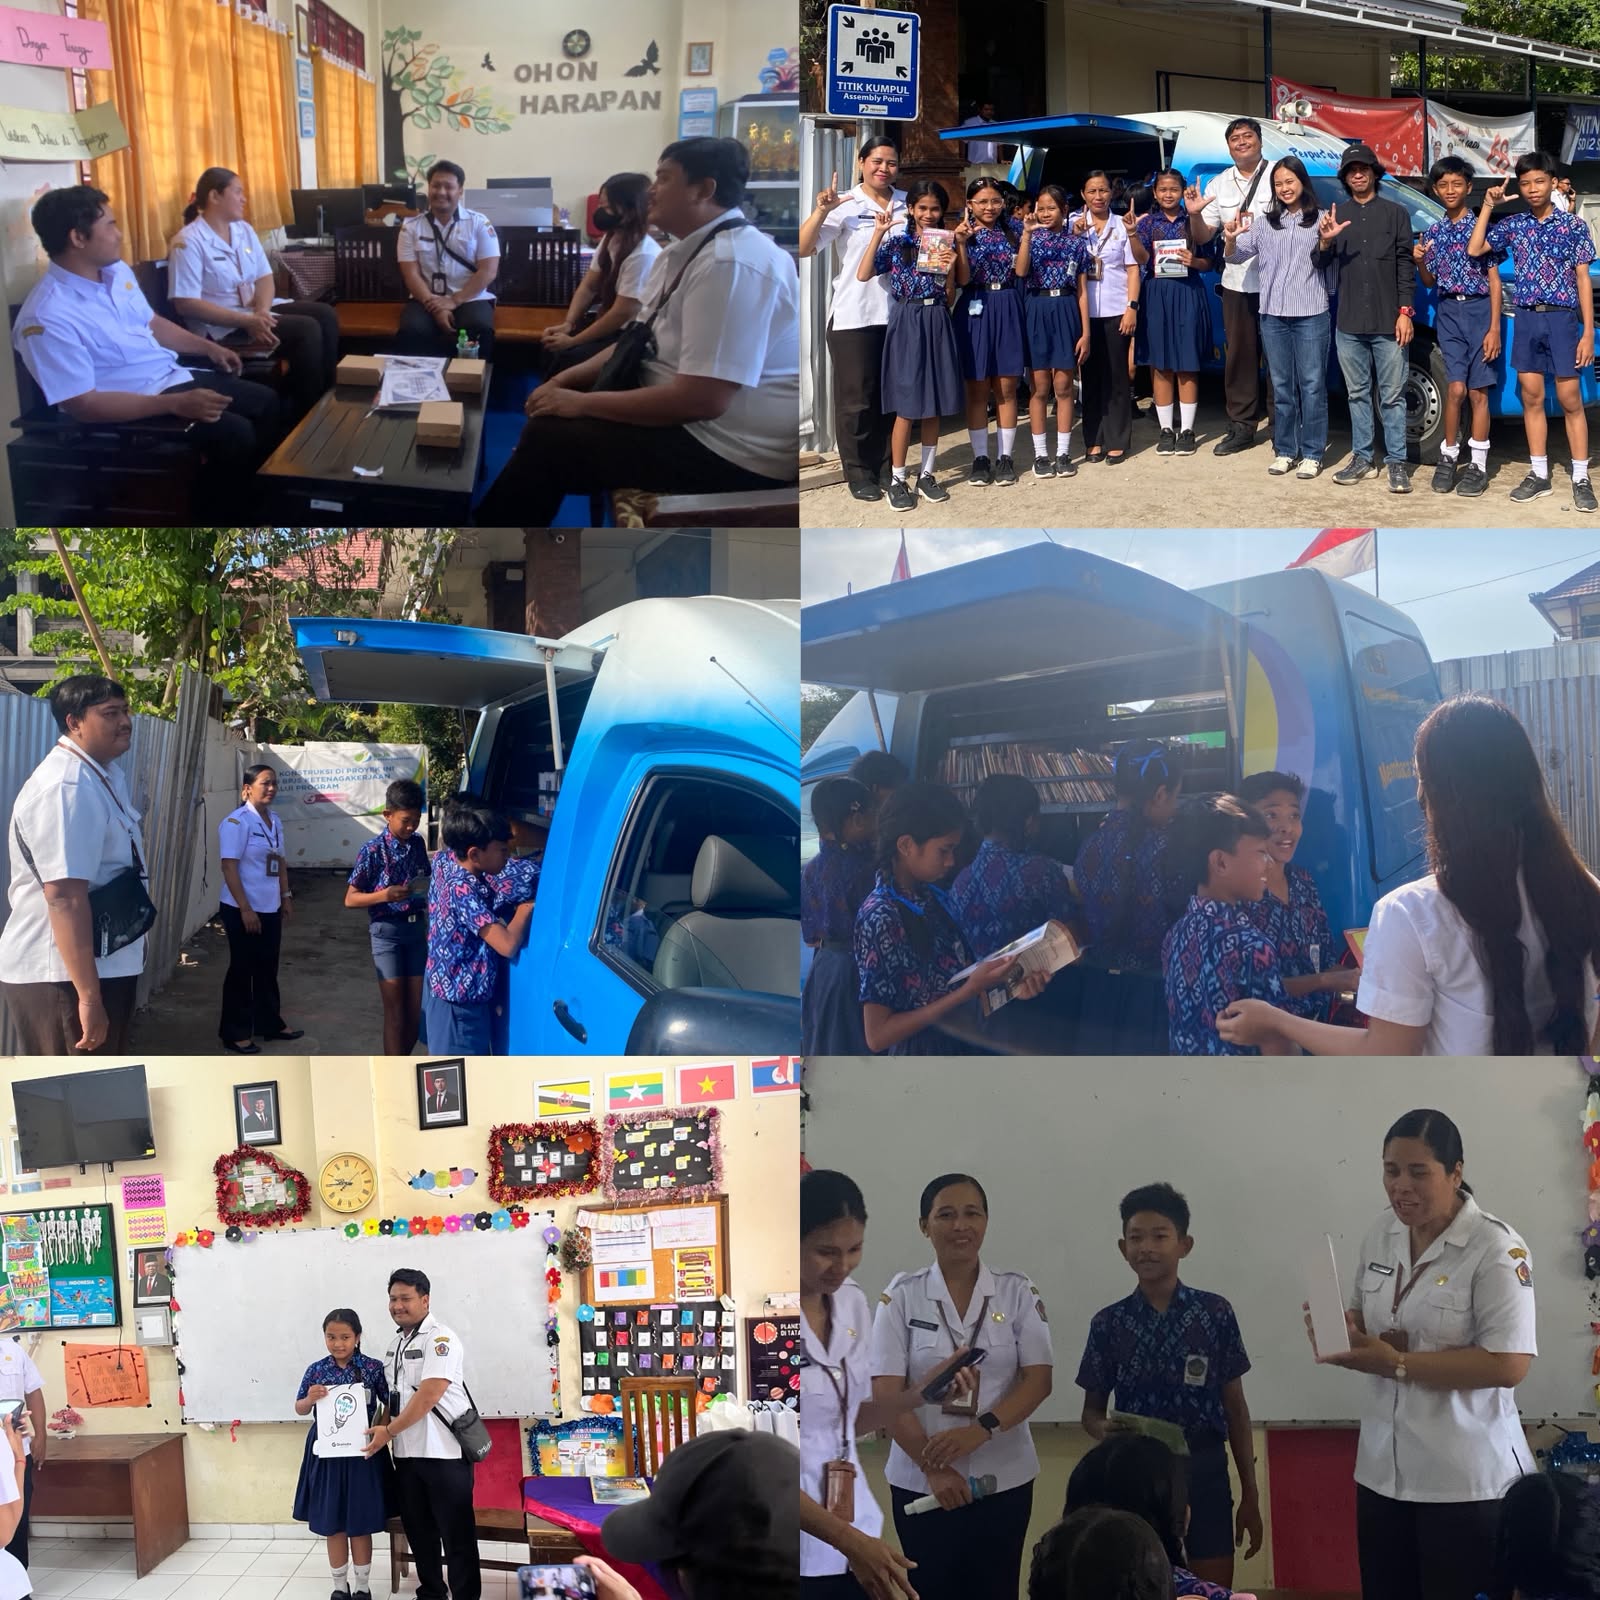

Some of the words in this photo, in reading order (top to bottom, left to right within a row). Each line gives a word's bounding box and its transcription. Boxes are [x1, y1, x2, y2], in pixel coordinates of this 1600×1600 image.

[513, 61, 598, 83] OHON
[836, 81, 864, 92] TITIK
[865, 83, 910, 95] KUMPUL
[519, 89, 662, 115] HARAPAN
[843, 92, 882, 103] Assembly
[882, 95, 903, 103] Point
[280, 768, 333, 777] KONSTRUKSI
[295, 783, 338, 792] PROGRAM
